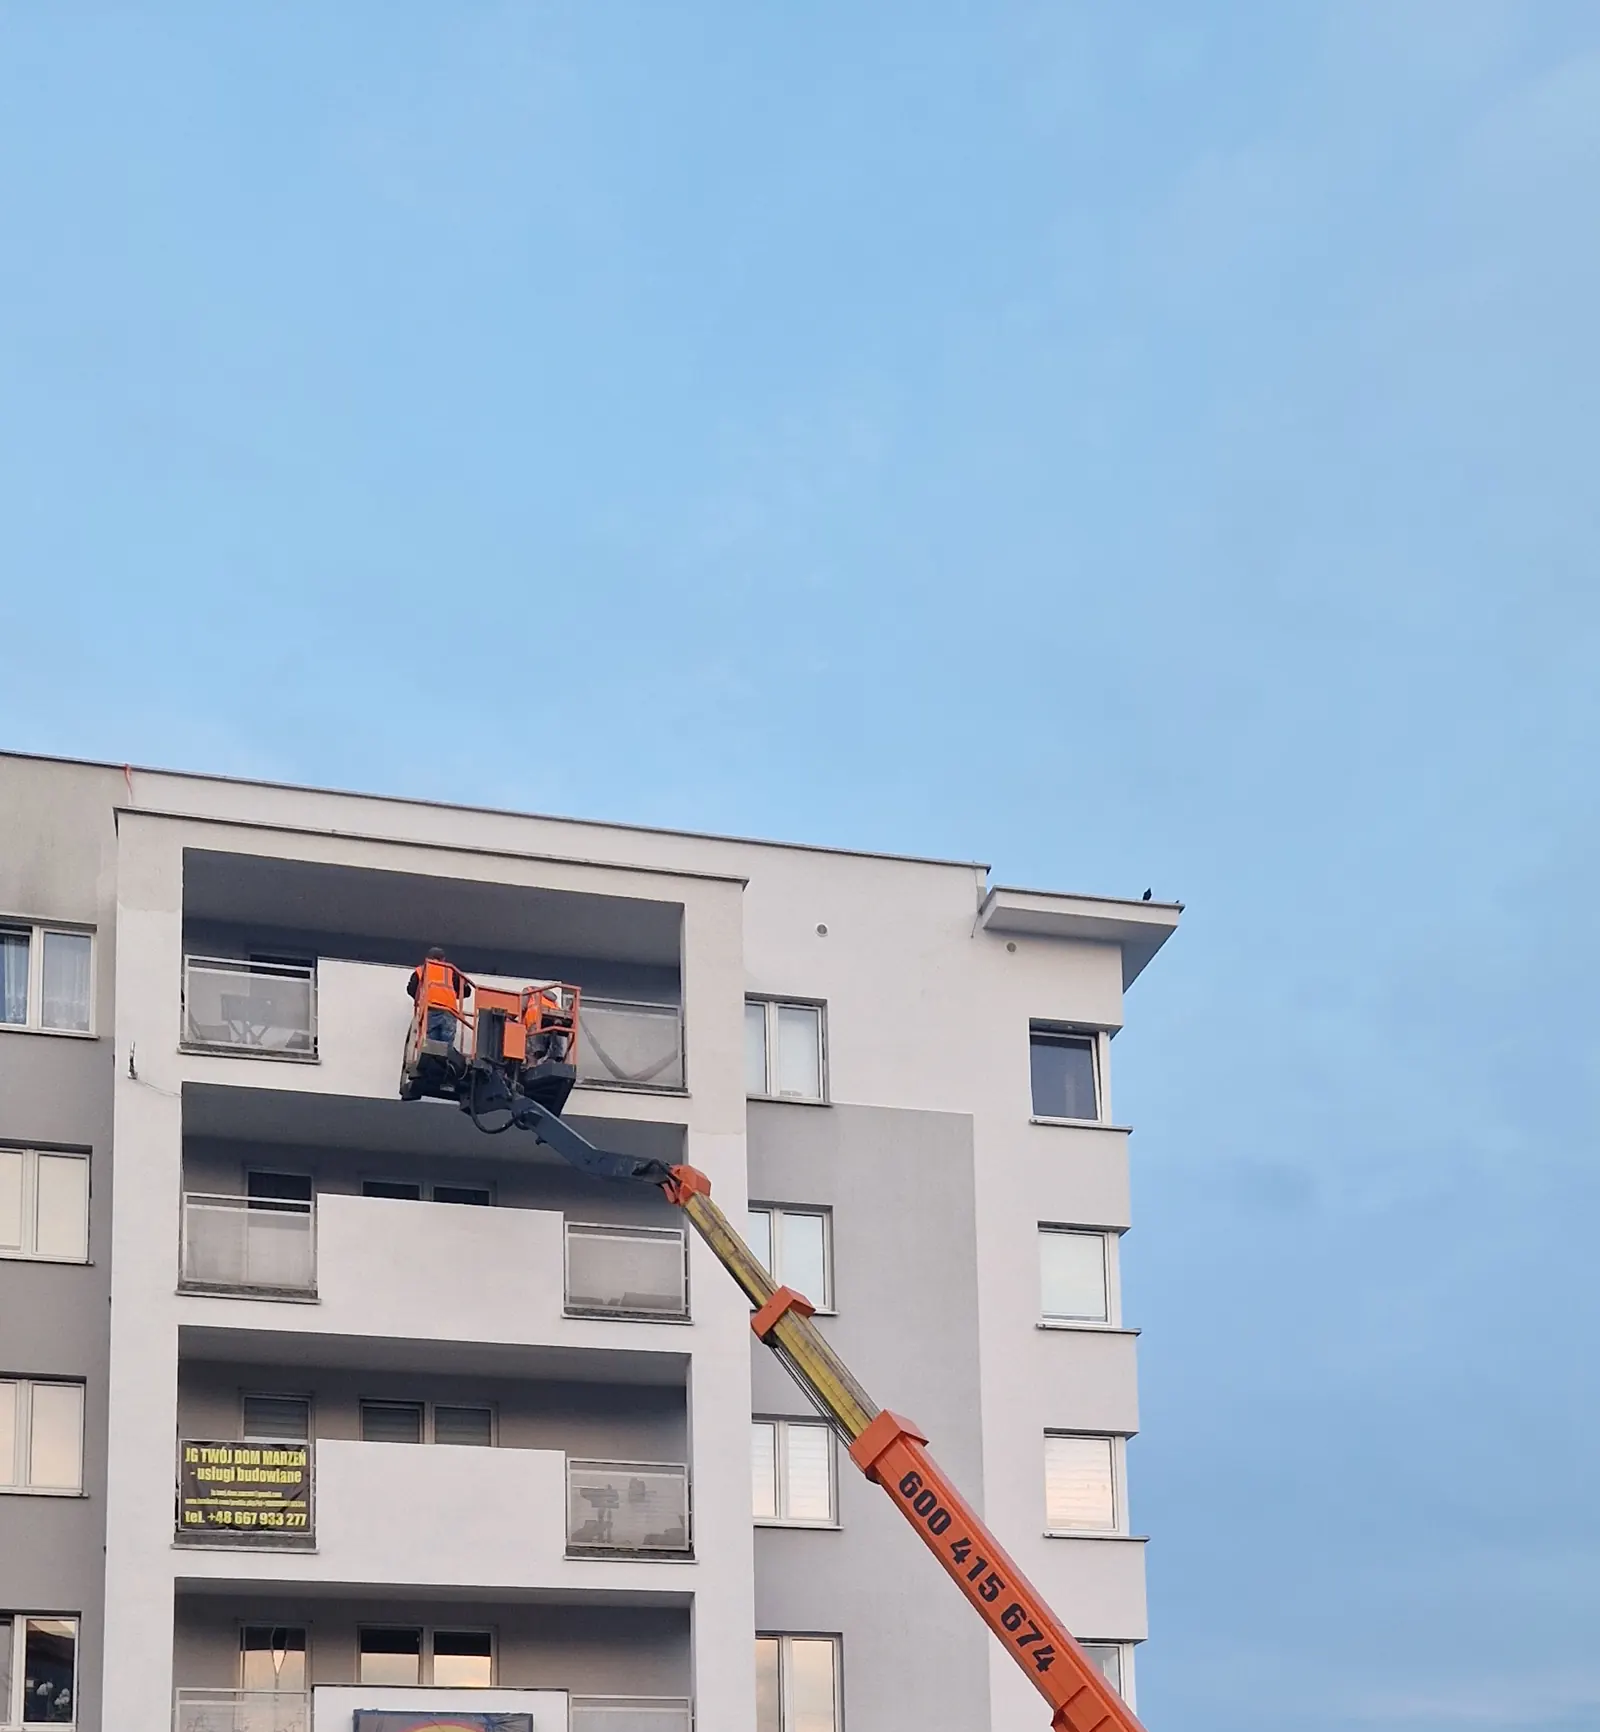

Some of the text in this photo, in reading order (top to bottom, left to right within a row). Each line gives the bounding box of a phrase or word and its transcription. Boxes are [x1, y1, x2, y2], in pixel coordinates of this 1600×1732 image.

[185, 1446, 307, 1466] JG TWÓJ DOM MARZEŃ
[197, 1466, 235, 1483] usługi
[236, 1466, 303, 1484] budowlane
[184, 1510, 307, 1526] tel. +48 667 933 277
[899, 1470, 1056, 1673] 600 415 674
